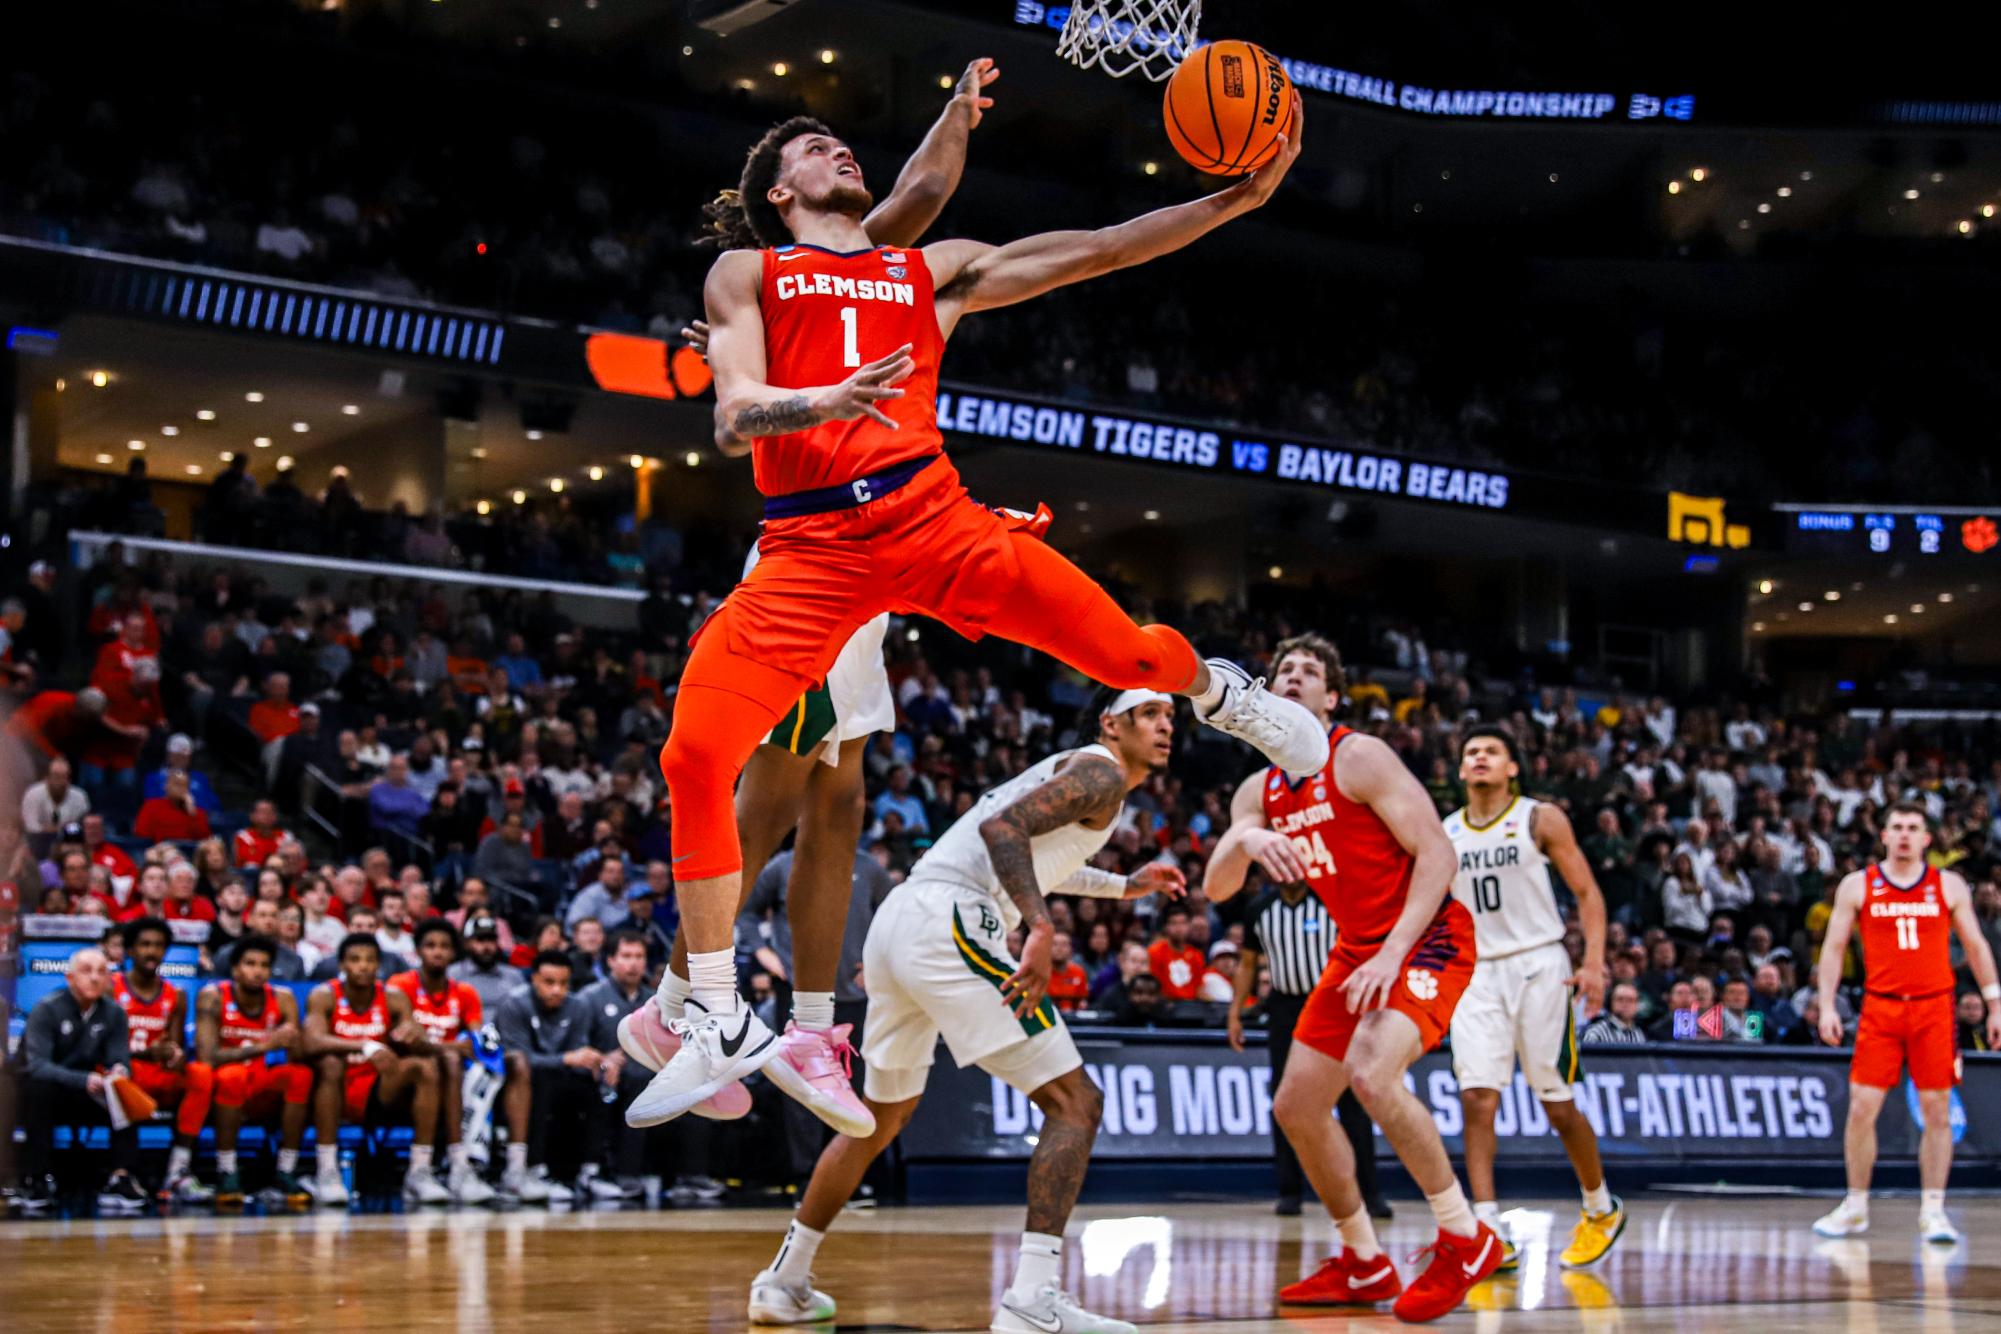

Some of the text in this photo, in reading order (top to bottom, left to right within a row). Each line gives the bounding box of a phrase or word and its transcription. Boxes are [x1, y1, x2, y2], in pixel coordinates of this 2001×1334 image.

[1281, 57, 1398, 107] ASKETBALL
[1400, 84, 1616, 119] CHAMPIONSHIP
[776, 273, 914, 307] CLEMSON
[841, 306, 861, 368] 1
[936, 393, 1509, 508] LEMSON TIGERS VS BAYLOR BEARS
[851, 479, 872, 503] C
[1460, 844, 1519, 871] AYLOR
[1472, 874, 1502, 914] 10
[1895, 917, 1920, 950] 11
[991, 1063, 1158, 1135] DNG
[1427, 1069, 1832, 1139] SUDNT-ATHLETES
